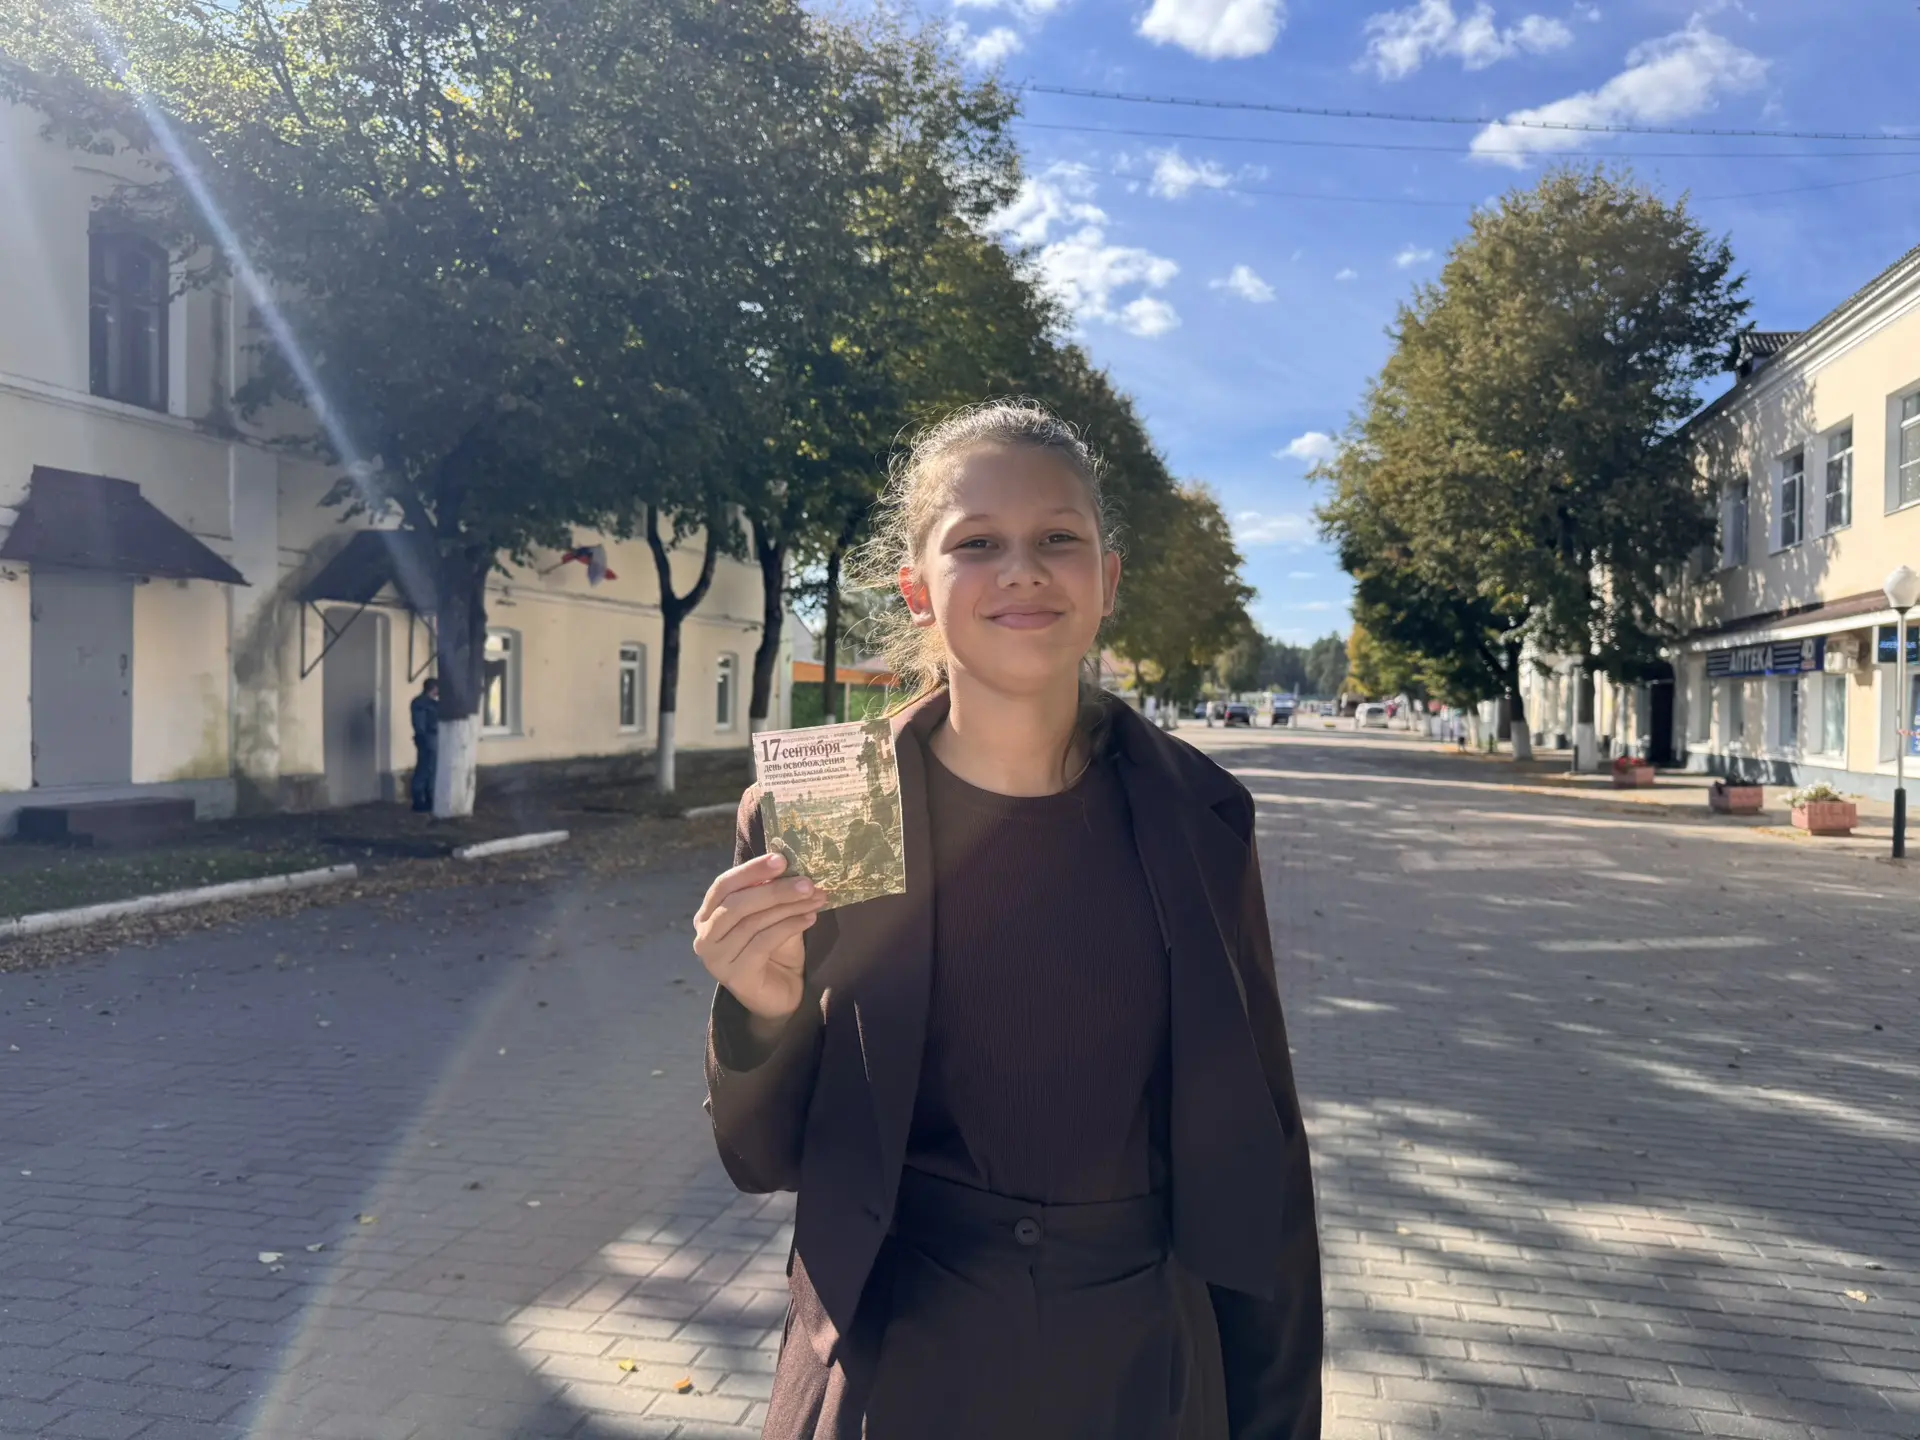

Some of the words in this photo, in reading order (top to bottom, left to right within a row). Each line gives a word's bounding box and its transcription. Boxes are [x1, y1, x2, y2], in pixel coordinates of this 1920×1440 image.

[1729, 646, 1774, 672] АПТЕКА
[761, 738, 781, 762] 17
[782, 740, 841, 758] сентября
[764, 764, 782, 773] день
[783, 757, 846, 770] освобождения
